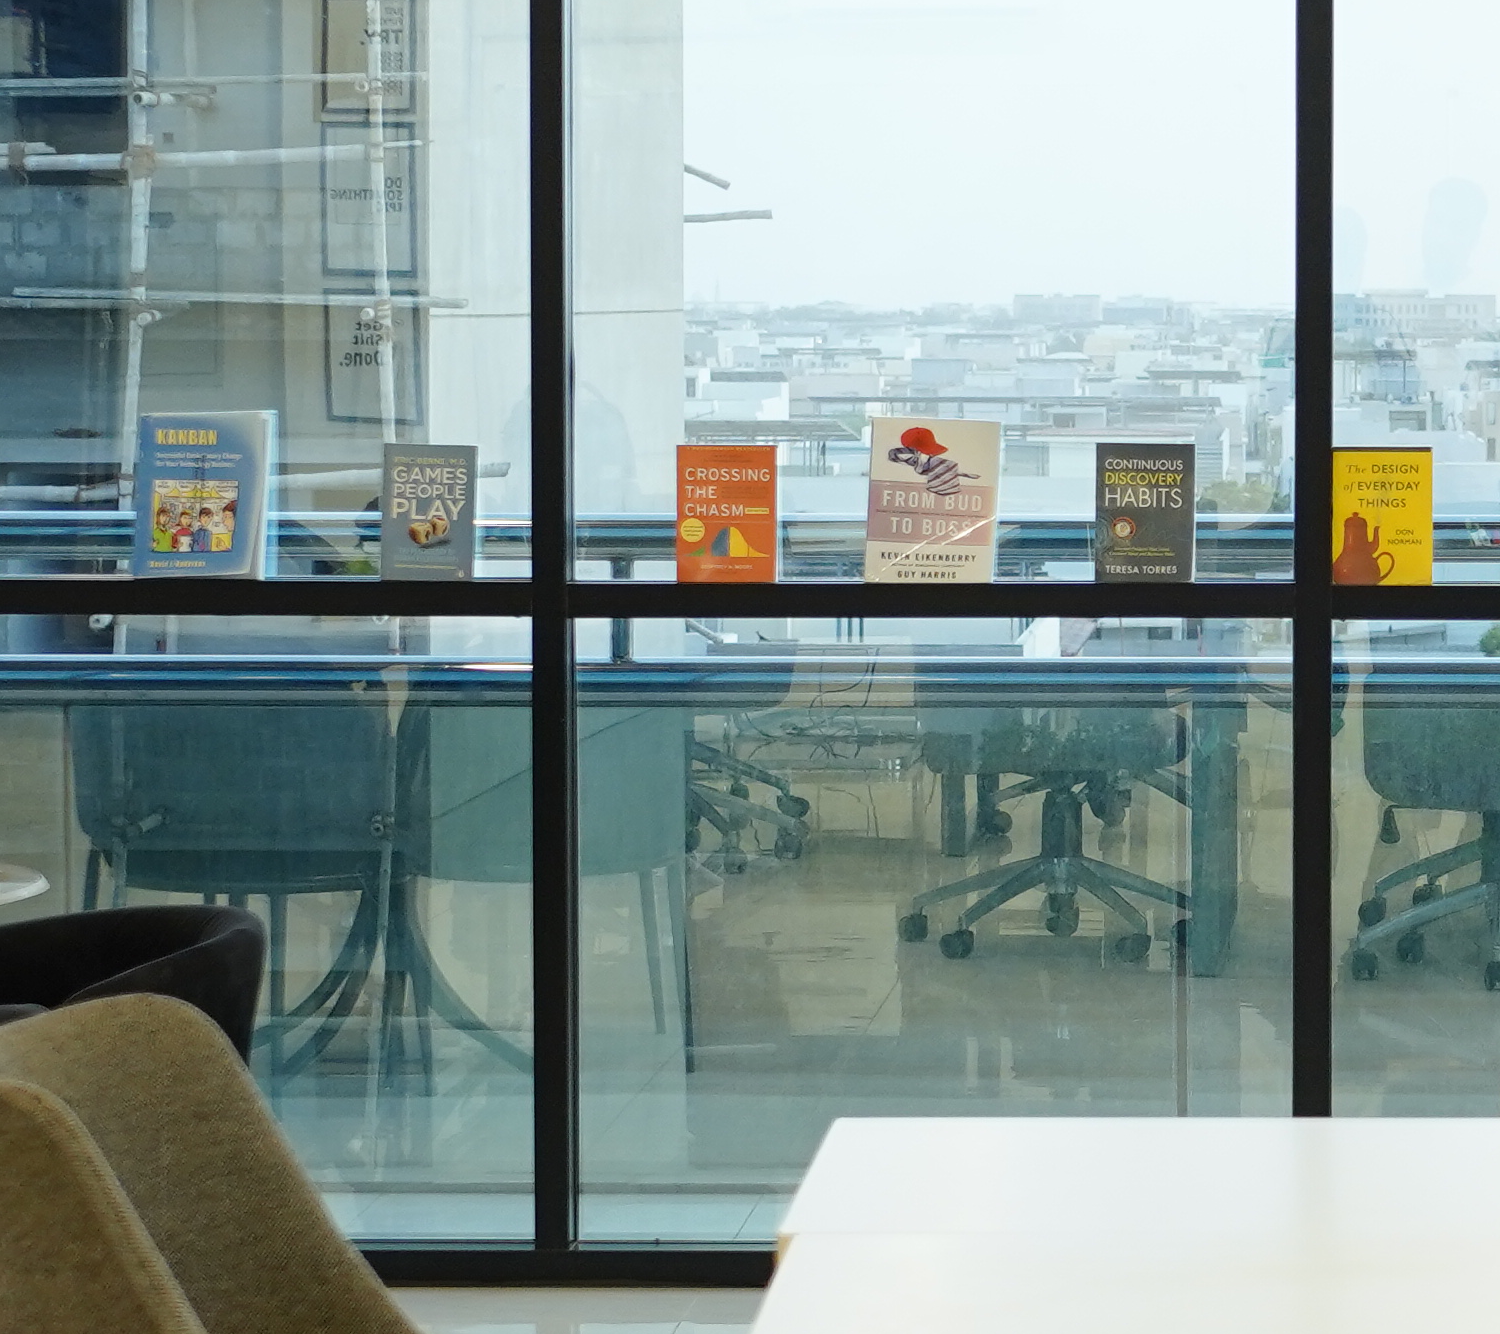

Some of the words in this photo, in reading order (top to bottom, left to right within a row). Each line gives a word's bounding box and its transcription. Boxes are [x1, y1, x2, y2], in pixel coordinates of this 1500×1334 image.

[155, 428, 217, 445] KANBAN
[1105, 459, 1184, 470] CONTINUOUS
[1371, 464, 1419, 474] DESIGN
[393, 466, 468, 484] GAMES
[685, 468, 771, 482] CROSSING
[1105, 472, 1184, 485] DISCOVERY
[393, 483, 467, 499] PEOPLE
[685, 485, 718, 499] THE
[1343, 481, 1356, 493] of
[1357, 481, 1420, 491] EVERYDAY
[882, 489, 935, 509] FROM
[945, 494, 982, 511] BUD
[1105, 487, 1183, 509] HABITS
[1358, 498, 1407, 508] THINGS
[391, 498, 466, 520] PLAY
[685, 503, 744, 516] CHASM
[890, 517, 912, 534] TO
[1105, 565, 1139, 574] TERESA
[1142, 565, 1177, 575] TORRES
